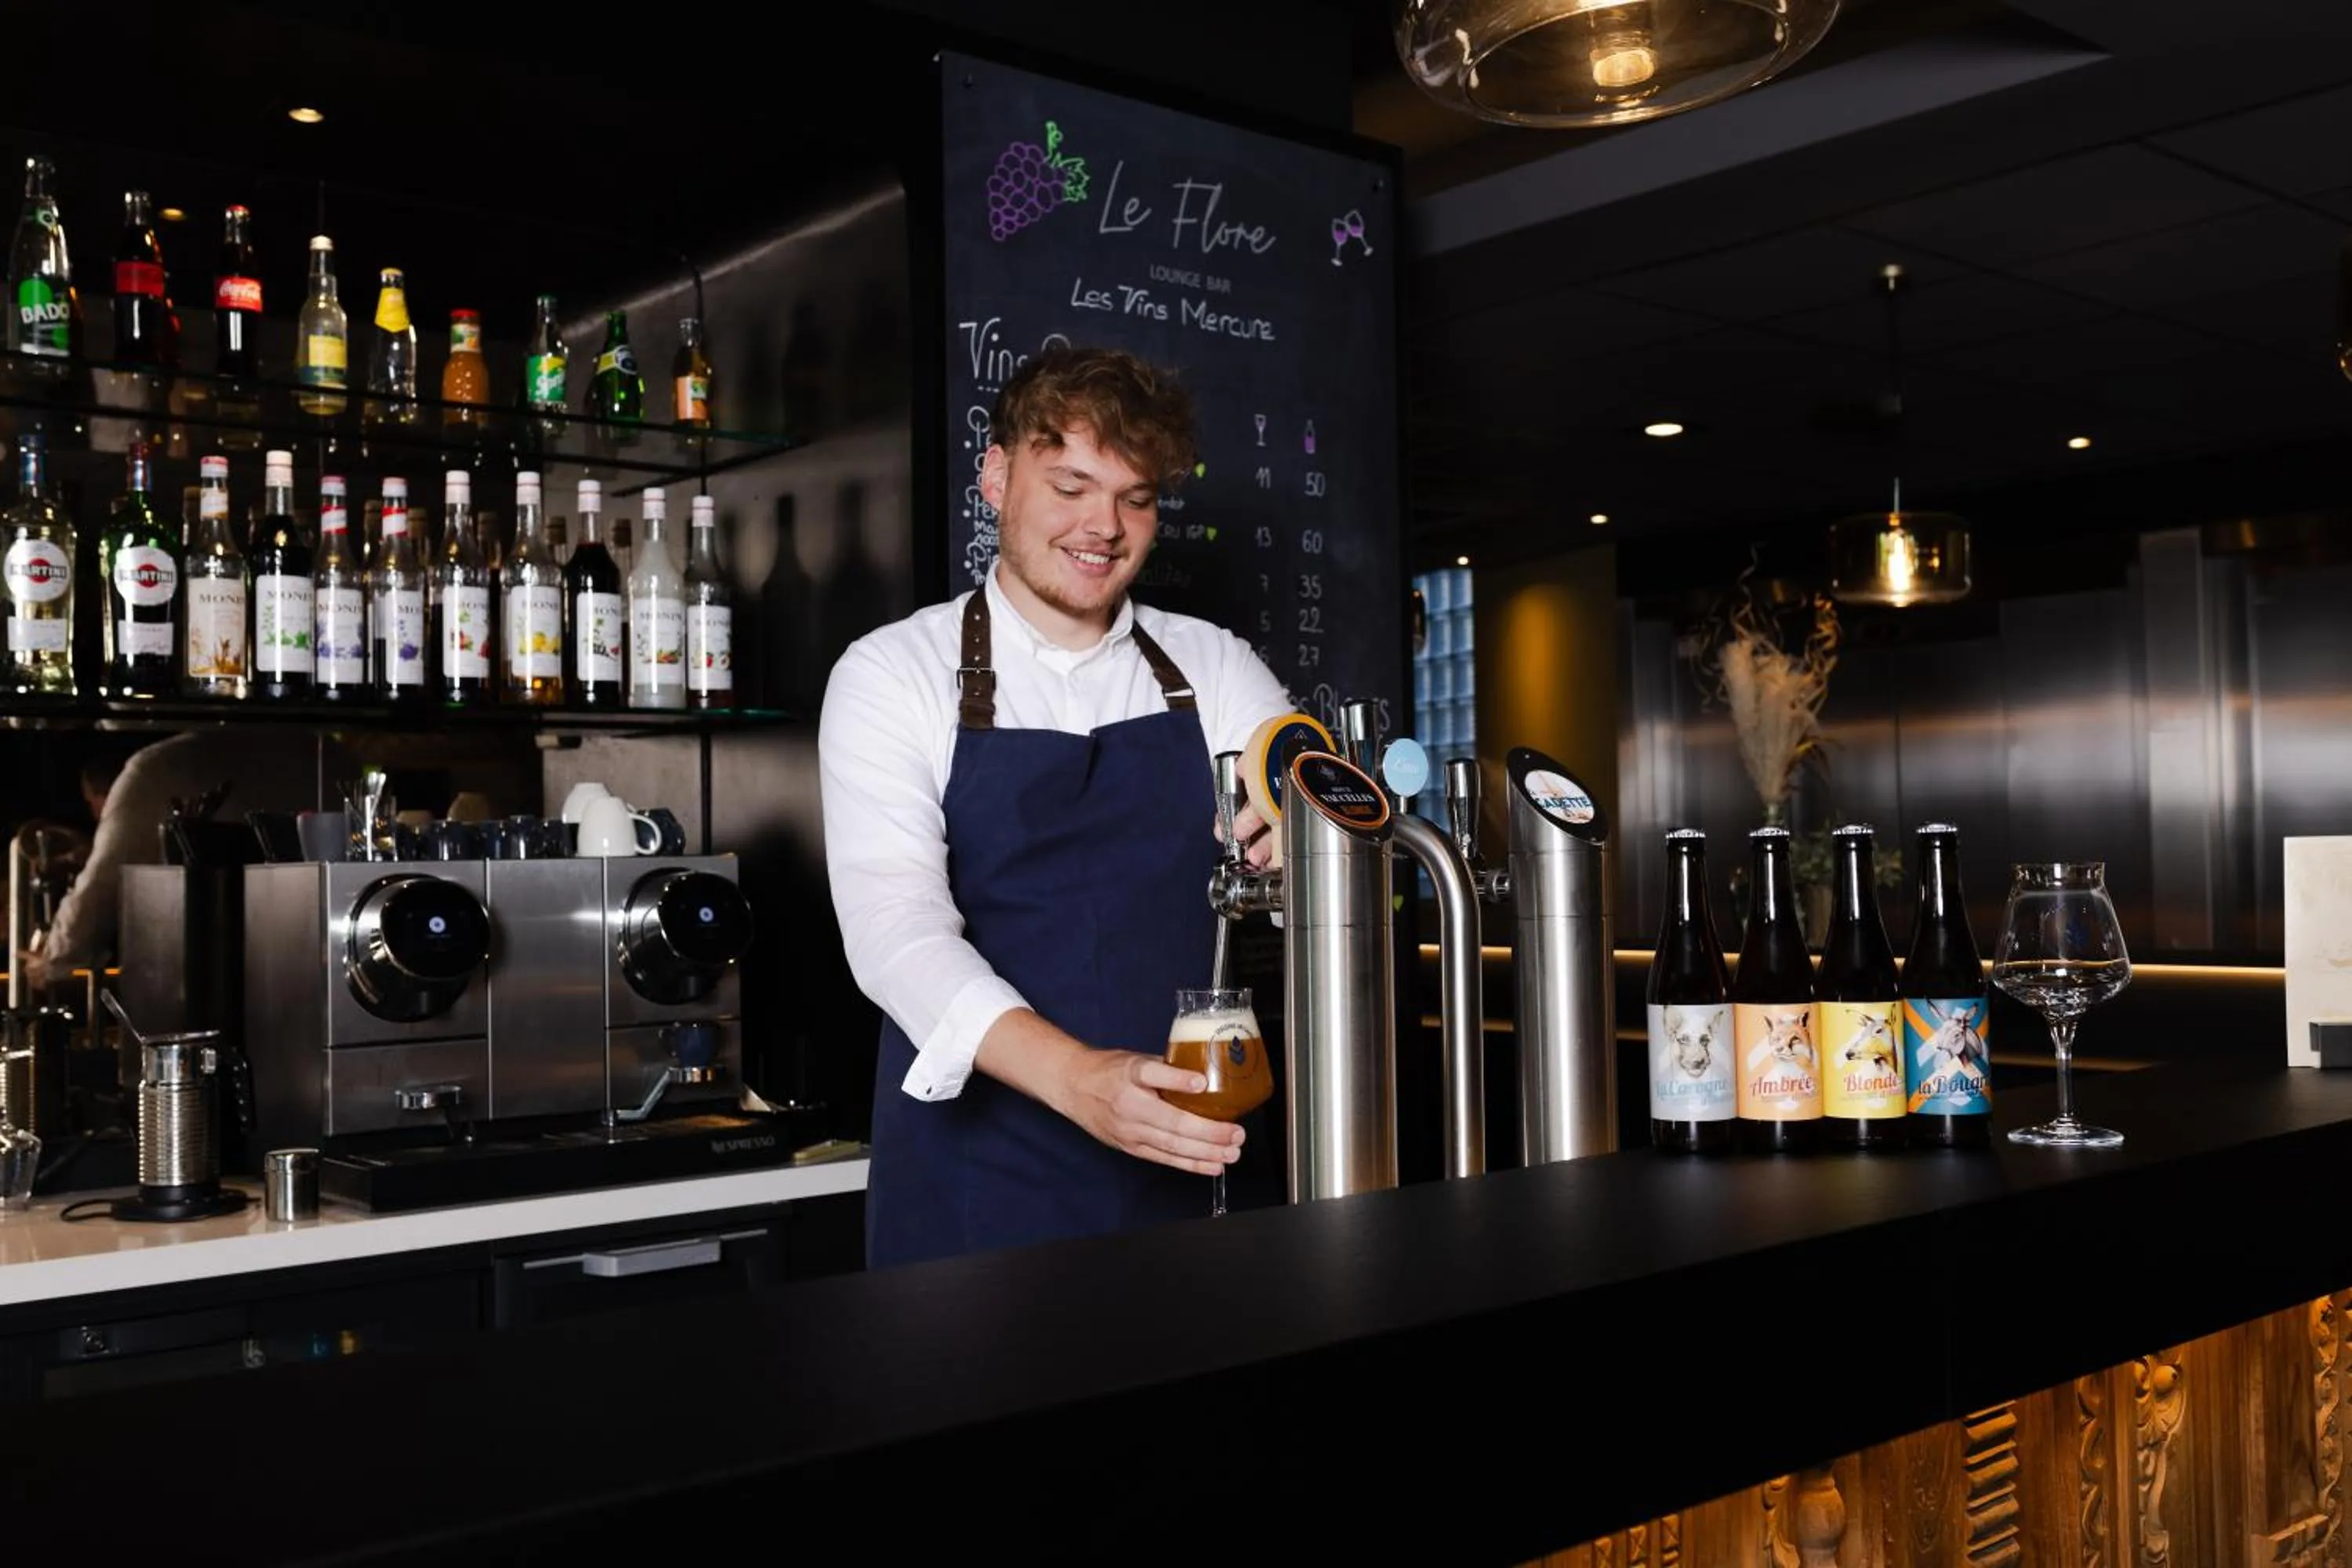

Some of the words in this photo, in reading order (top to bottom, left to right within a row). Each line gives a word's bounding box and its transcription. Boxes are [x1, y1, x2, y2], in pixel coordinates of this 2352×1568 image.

[1099, 160, 1152, 234] Le
[1172, 177, 1277, 254] Flore
[1149, 263, 1201, 289] LOUNGE
[1206, 275, 1232, 294] BAR
[1070, 276, 1114, 311] Les
[1117, 284, 1169, 321] Vins
[1181, 297, 1276, 341] Mercure
[1304, 472, 1325, 496] 50
[1256, 527, 1272, 547] 13
[1302, 529, 1323, 554] 60
[1299, 575, 1322, 599] 35
[1298, 607, 1324, 633] 22
[1298, 644, 1319, 666] 27
